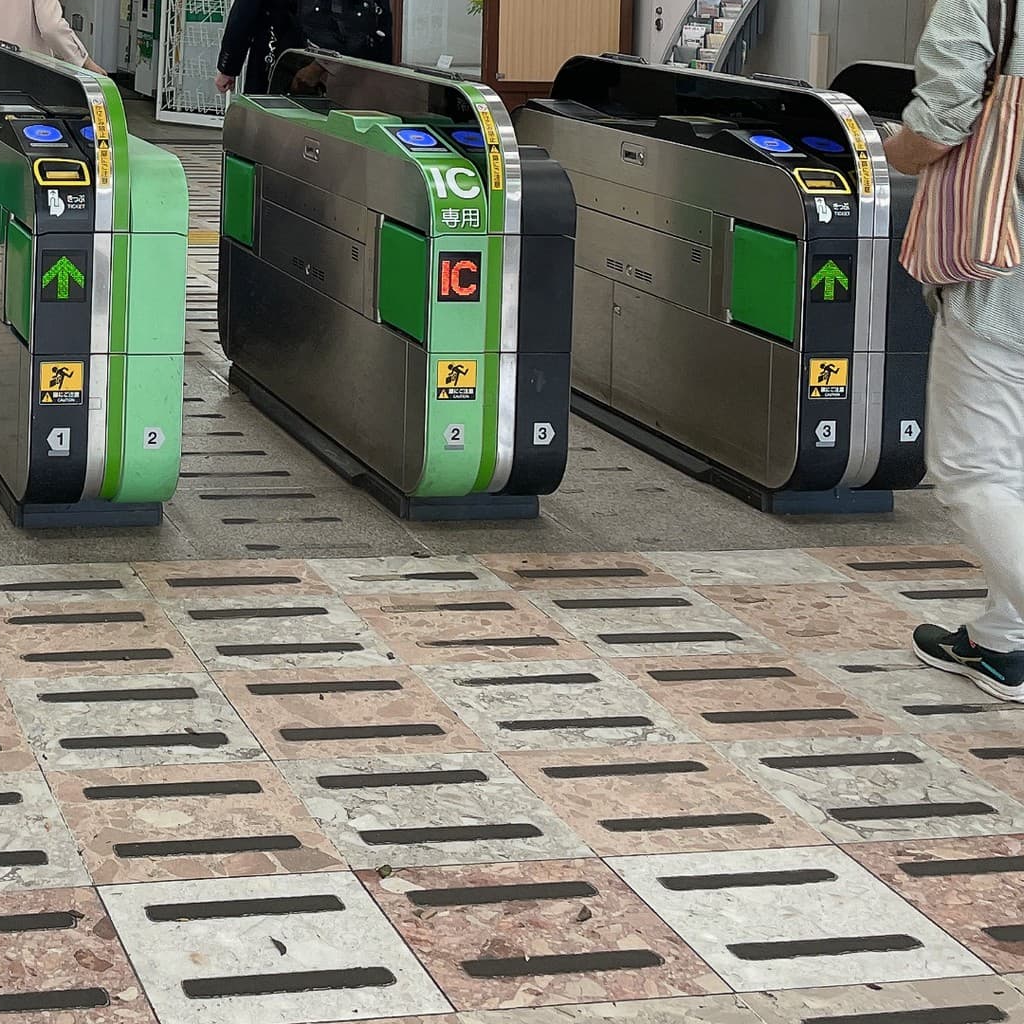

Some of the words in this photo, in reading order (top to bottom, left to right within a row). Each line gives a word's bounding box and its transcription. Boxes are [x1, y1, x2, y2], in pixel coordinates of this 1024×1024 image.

[430, 167, 480, 199] IC
[441, 208, 480, 228] 専用
[441, 260, 478, 296] IC
[450, 428, 460, 441] 2
[538, 427, 547, 440] 3
[822, 425, 831, 438] 3
[904, 424, 913, 437] 4
[56, 432, 64, 446] 1
[147, 431, 157, 445] 2
